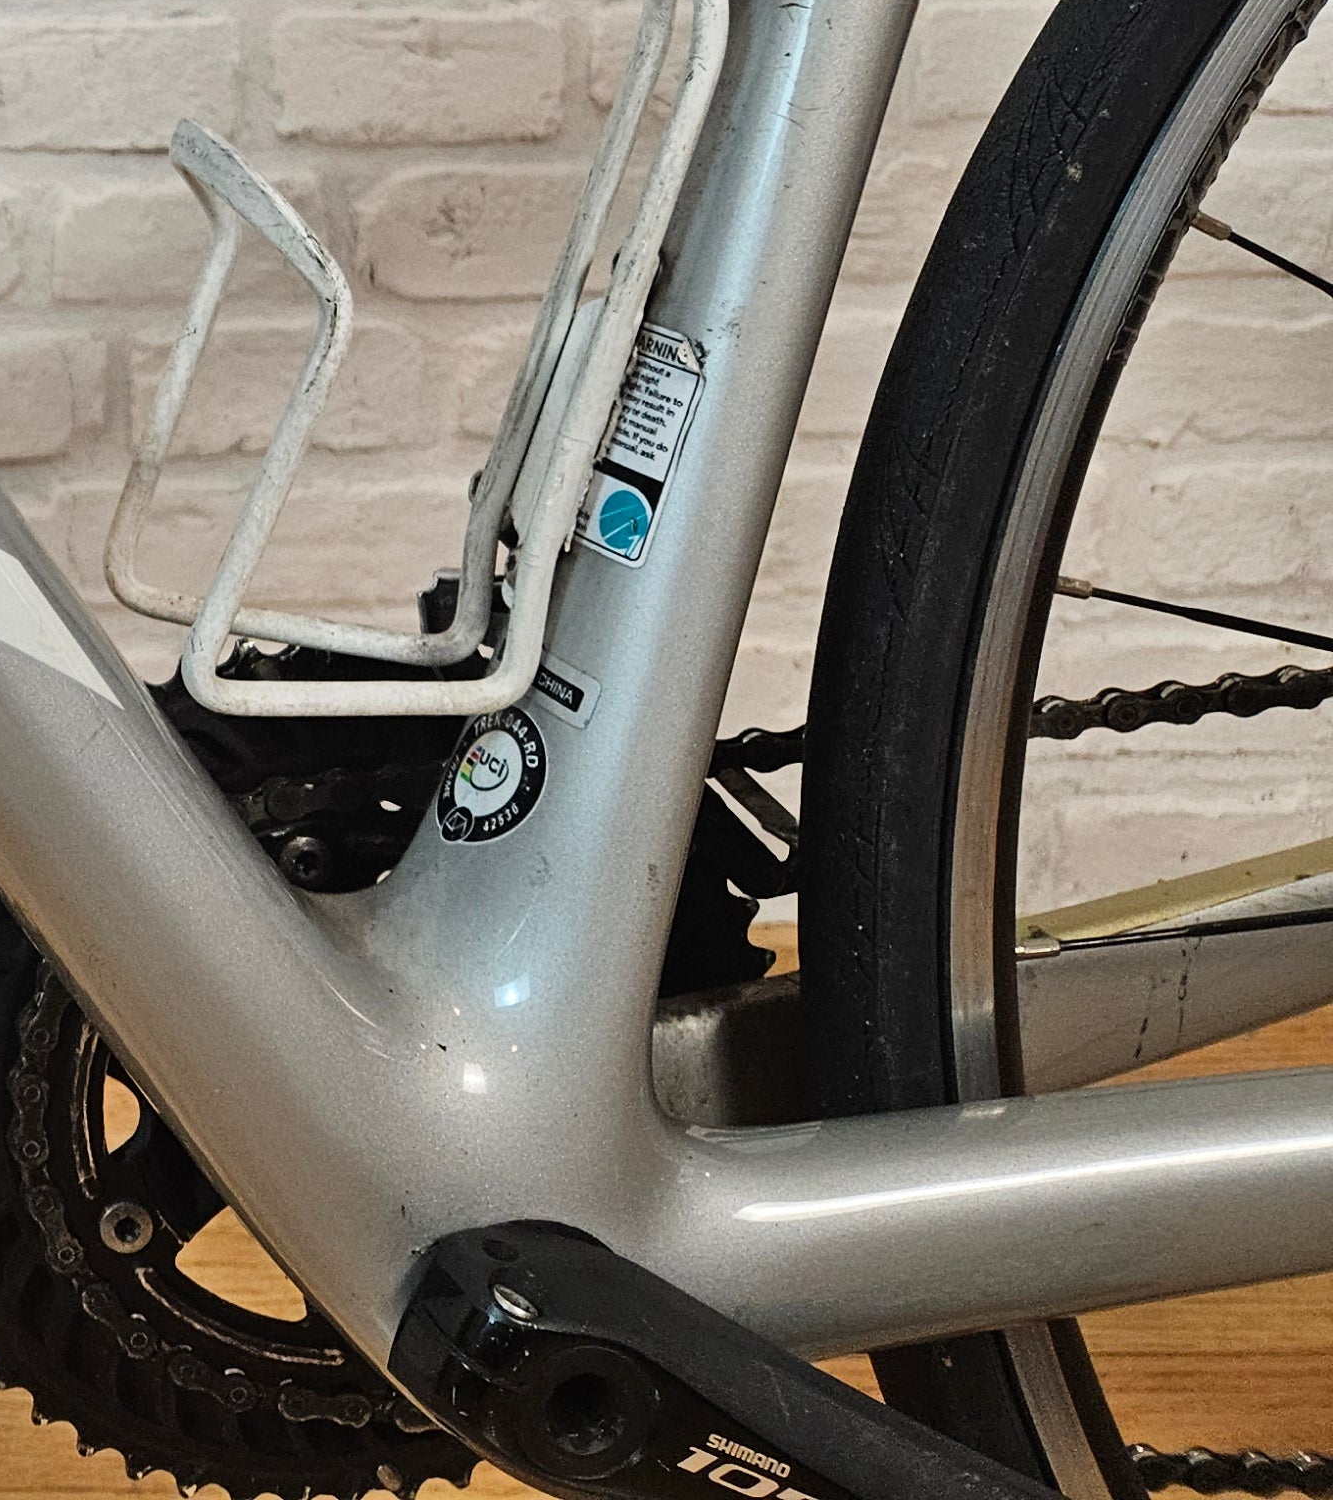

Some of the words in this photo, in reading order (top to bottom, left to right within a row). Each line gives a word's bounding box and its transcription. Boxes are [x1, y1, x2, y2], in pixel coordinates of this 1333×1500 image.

[672, 397, 684, 408] to
[665, 407, 675, 417] in
[627, 419, 657, 435] manual
[638, 435, 655, 448] you
[655, 441, 669, 452] do
[537, 671, 574, 705] CHINA
[706, 1432, 791, 1479] SHIMANO
[676, 1445, 820, 1500] 10
